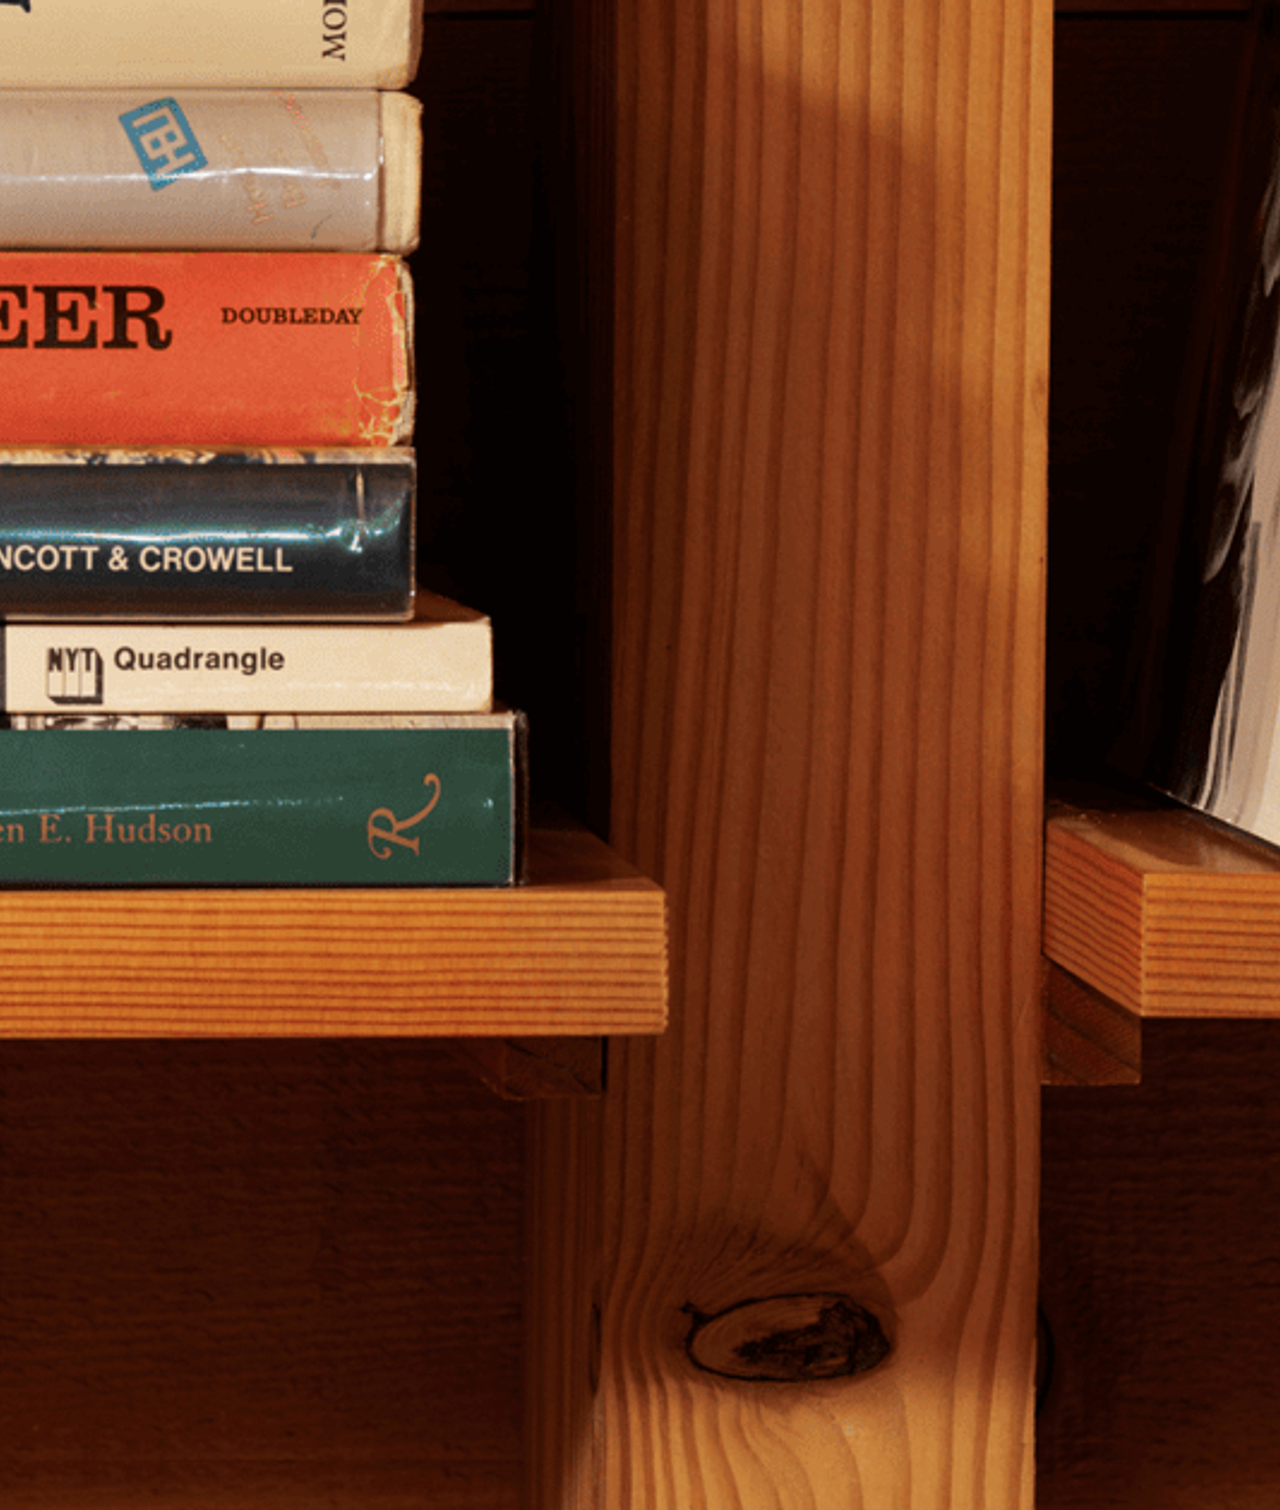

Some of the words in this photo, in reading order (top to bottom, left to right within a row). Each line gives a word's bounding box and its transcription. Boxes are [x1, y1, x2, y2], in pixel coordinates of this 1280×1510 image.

[321, 0, 348, 61] MO
[221, 308, 363, 325] DOUBLEDAY
[108, 545, 128, 572] &
[137, 544, 293, 573] CROWELL
[48, 647, 97, 672] NYT
[113, 646, 285, 672] Quadrangle
[40, 812, 72, 843] E.
[85, 812, 212, 843] Hudson
